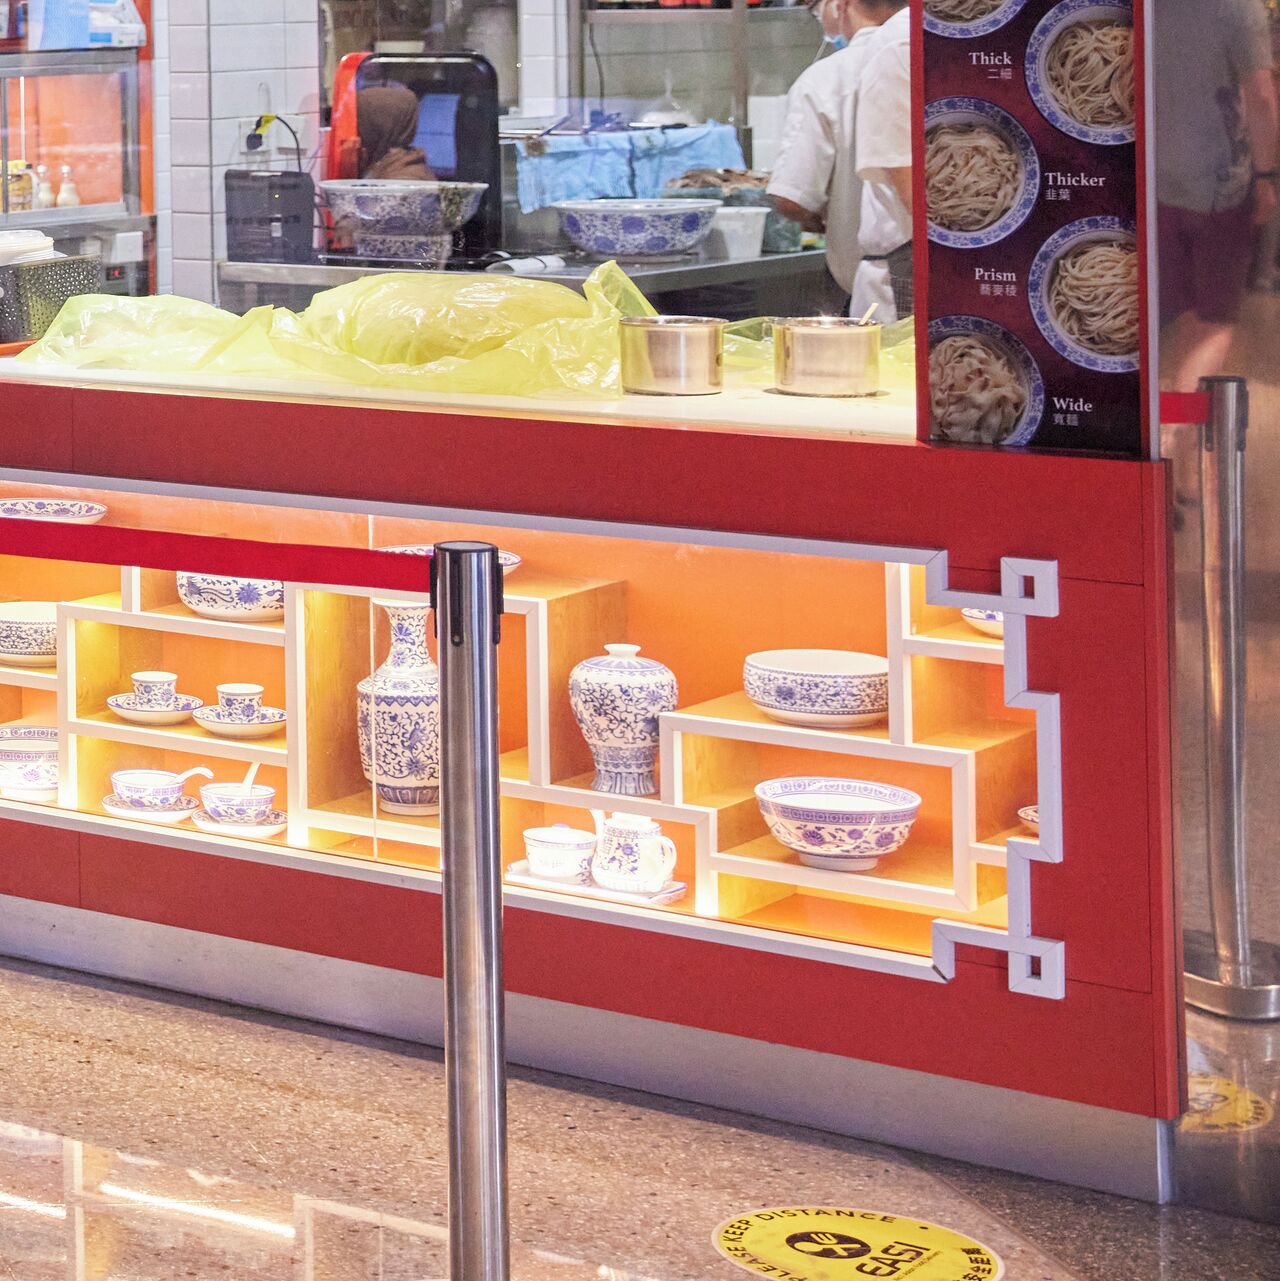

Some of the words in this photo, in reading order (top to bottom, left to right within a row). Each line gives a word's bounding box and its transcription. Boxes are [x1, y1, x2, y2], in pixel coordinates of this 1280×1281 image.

[968, 51, 1012, 66] Thick
[987, 67, 1012, 80] 二細
[1044, 172, 1106, 188] Thicker
[974, 267, 1017, 282] Prism
[1053, 396, 1093, 413] Wide
[723, 1219, 752, 1243] KEEP
[755, 1209, 897, 1224] DISTANCE
[855, 1241, 931, 1278] EASI
